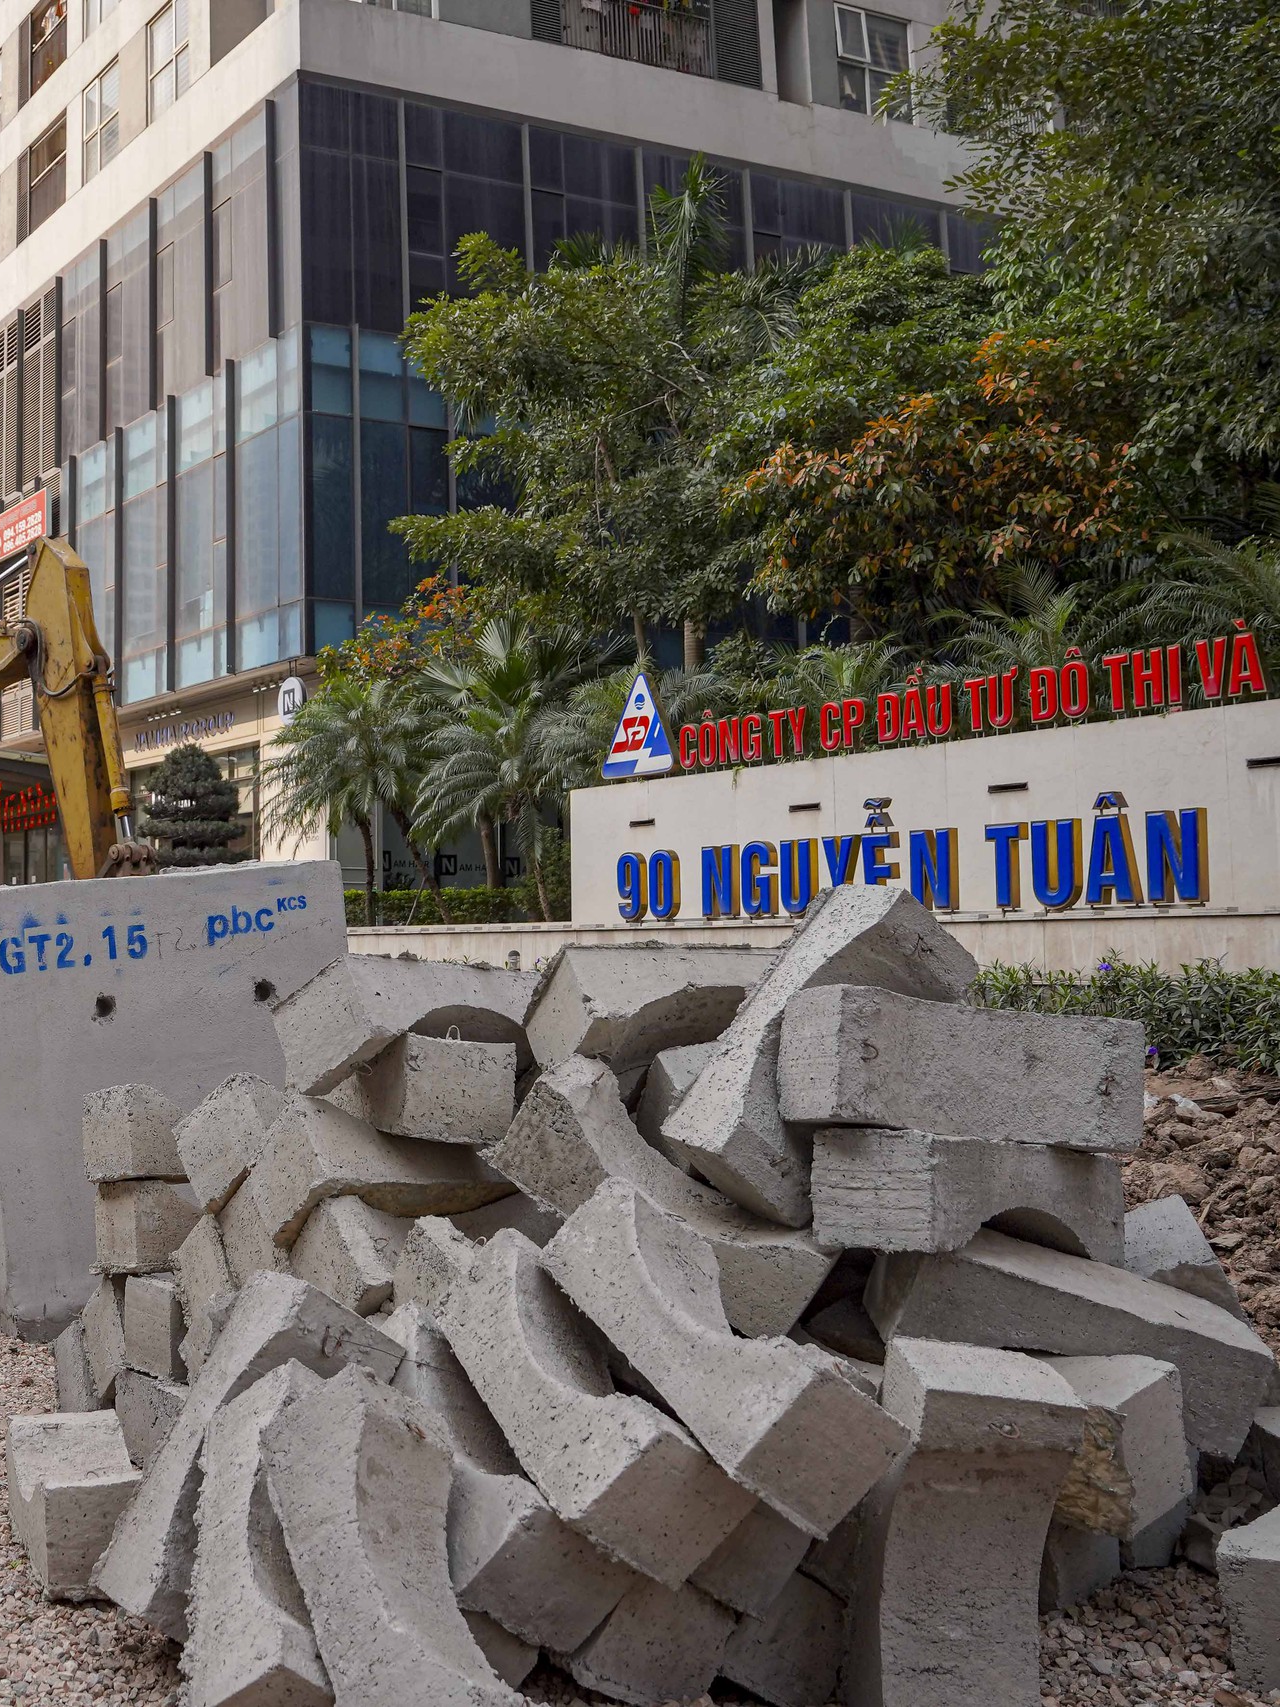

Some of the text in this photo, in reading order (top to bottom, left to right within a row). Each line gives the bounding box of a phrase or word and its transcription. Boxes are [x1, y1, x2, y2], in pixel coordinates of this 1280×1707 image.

[190, 711, 235, 741] GROUP
[679, 618, 1267, 769] CÔNG TY CP ĐẦU TƯ ĐÔ THỊ VÀ
[616, 791, 1210, 922] 90 NGUYỄN TUÂN
[276, 895, 308, 912] KCS
